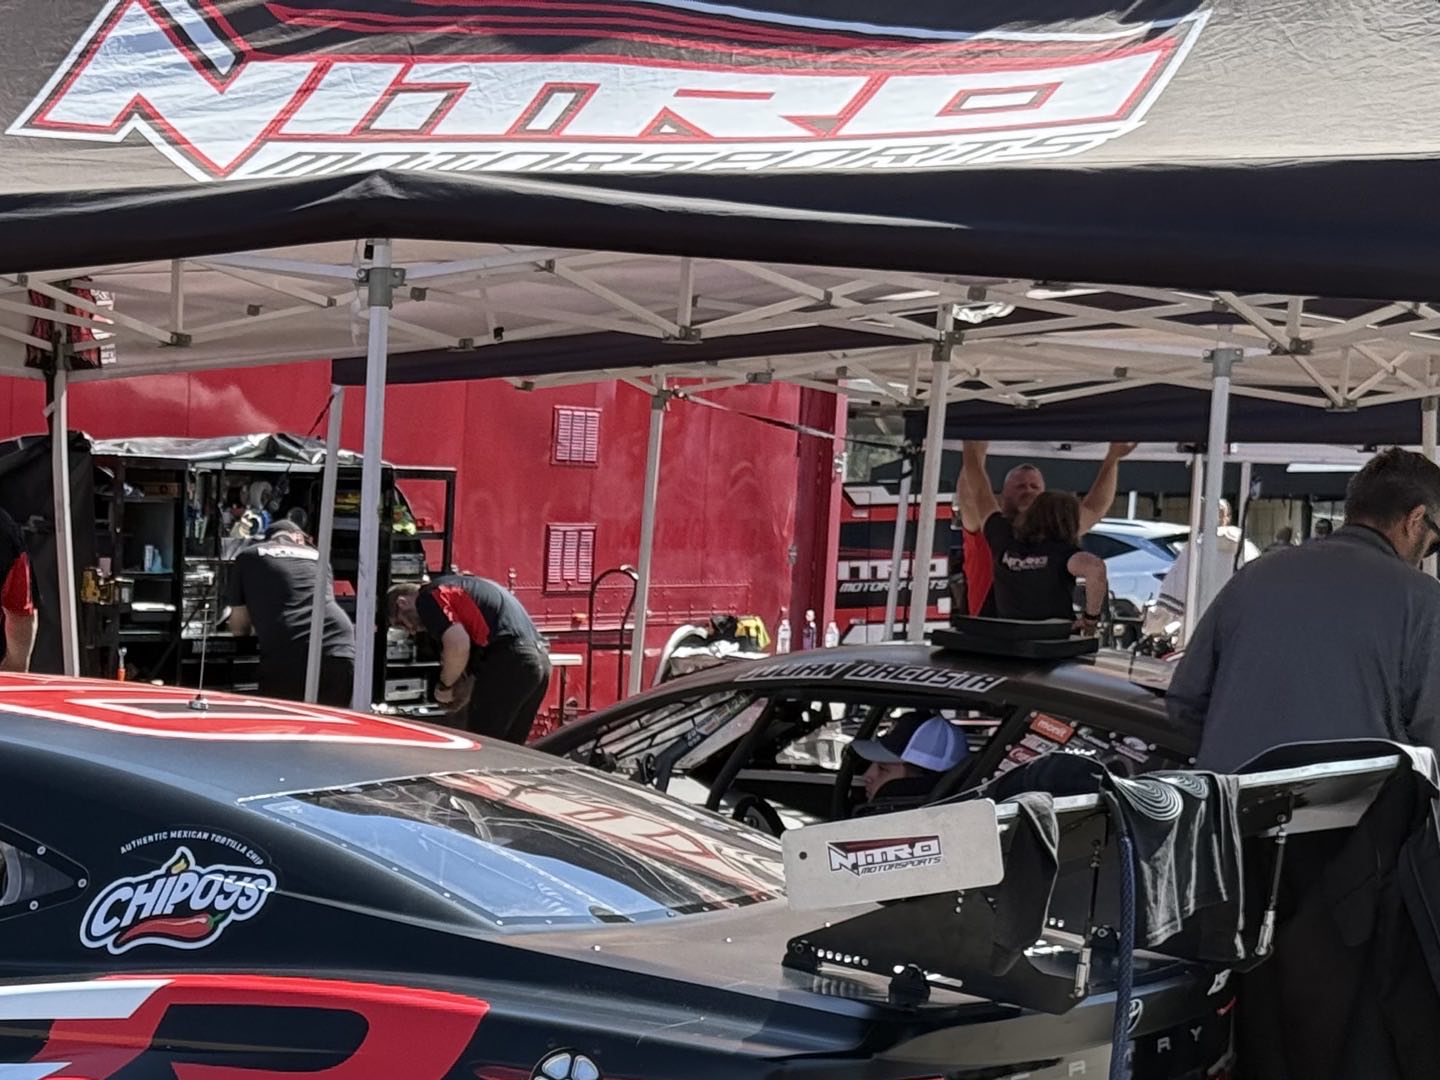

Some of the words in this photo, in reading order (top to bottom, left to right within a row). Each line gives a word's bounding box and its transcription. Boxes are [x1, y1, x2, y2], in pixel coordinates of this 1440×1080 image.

[10, 0, 1200, 178] NITRO
[120, 831, 168, 855] AUTHENTIC
[170, 830, 209, 841] MEXICAN
[210, 833, 248, 854] TORTILLA
[245, 850, 264, 865] CHIP
[828, 840, 941, 876] NITRO
[860, 856, 942, 875] MOTORSPORTS
